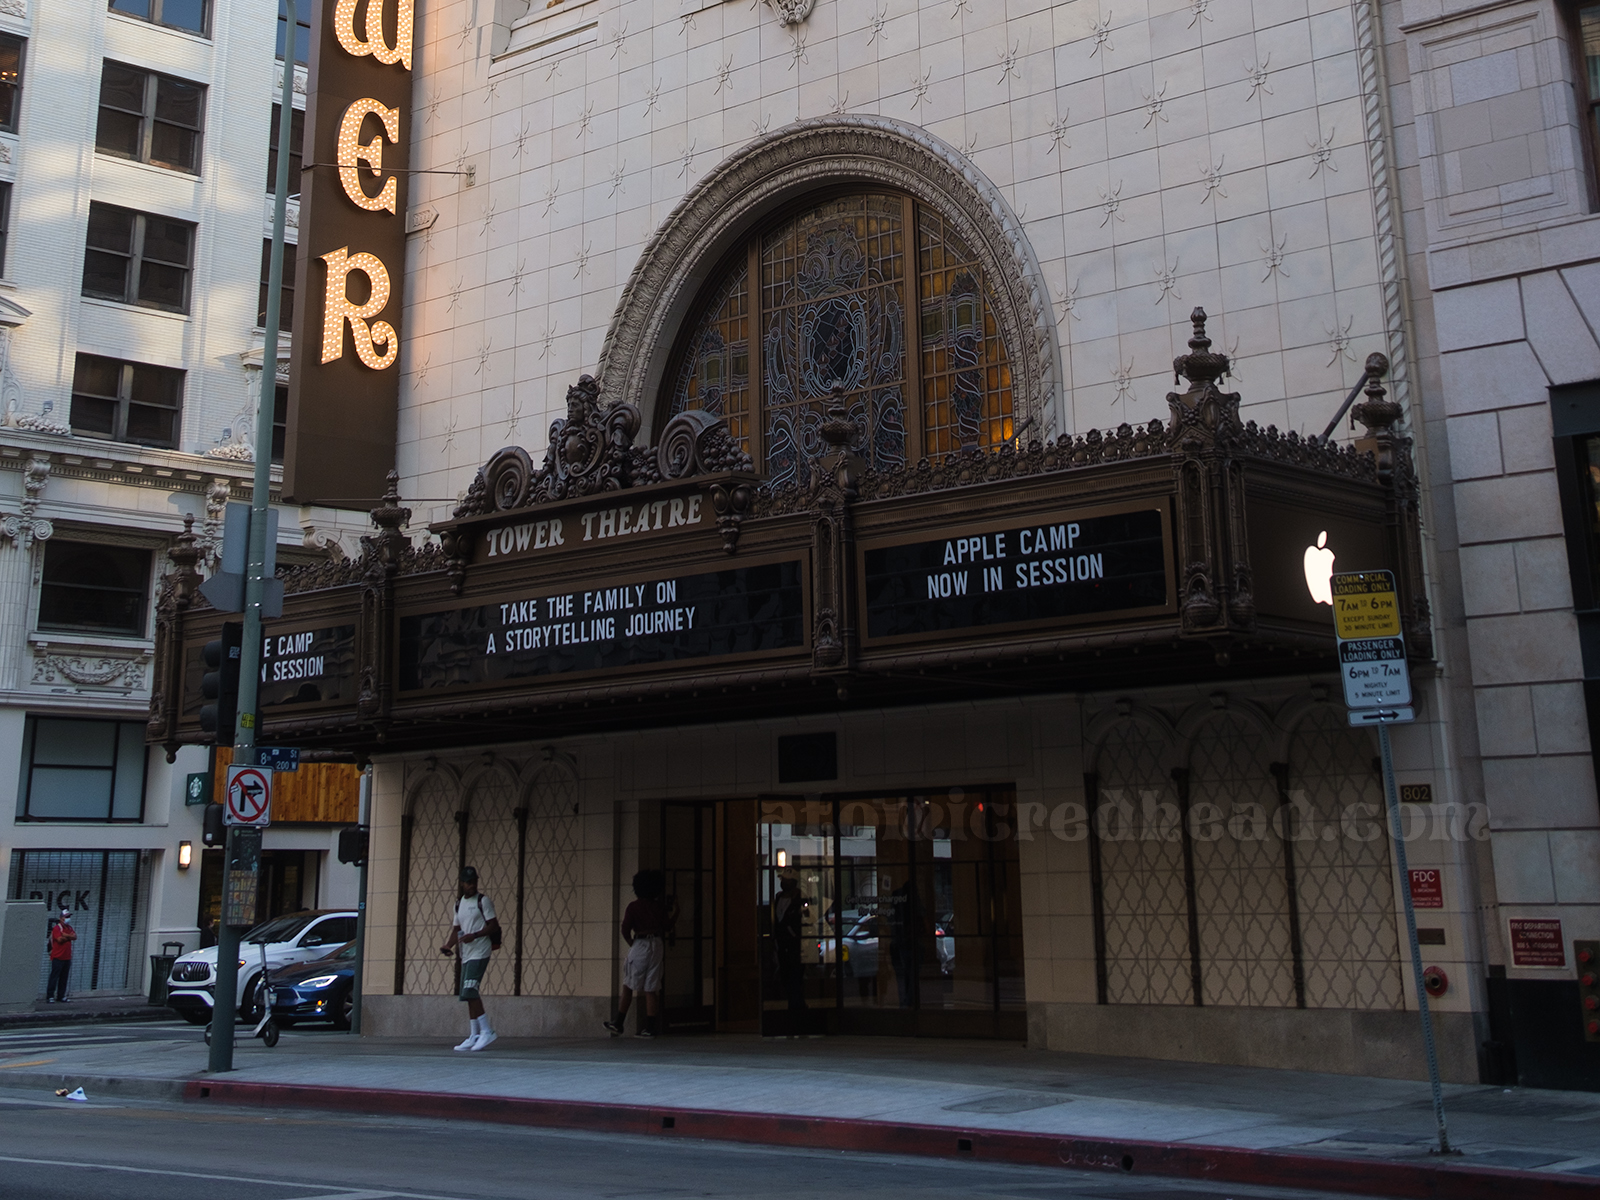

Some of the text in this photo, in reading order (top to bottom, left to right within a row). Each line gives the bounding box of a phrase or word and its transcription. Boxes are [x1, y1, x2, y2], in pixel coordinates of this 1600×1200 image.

[486, 495, 703, 557] TOWER THEATRE
[943, 522, 1081, 566] APPLE CAMP
[926, 552, 1104, 600] NOW IN SESSION
[1334, 582, 1392, 595] LOADING ONLY
[500, 579, 677, 626] TAKE THE FAMILY ON
[1343, 614, 1391, 623] EXCEPT SUNDAY
[485, 606, 697, 654] A STORYTELLING JOURNEY
[1354, 623, 1376, 631] MINUTE
[277, 632, 314, 656] CAMP
[1347, 640, 1395, 651] PASSENGER
[1343, 649, 1401, 662] LOADING ONLY
[273, 655, 324, 681] SESSION
[1364, 681, 1388, 689] NIGHTLY
[1361, 690, 1384, 698] MINUTE
[275, 760, 290, 770] 200
[1403, 786, 1430, 800] 802
[1412, 870, 1436, 883] FDC
